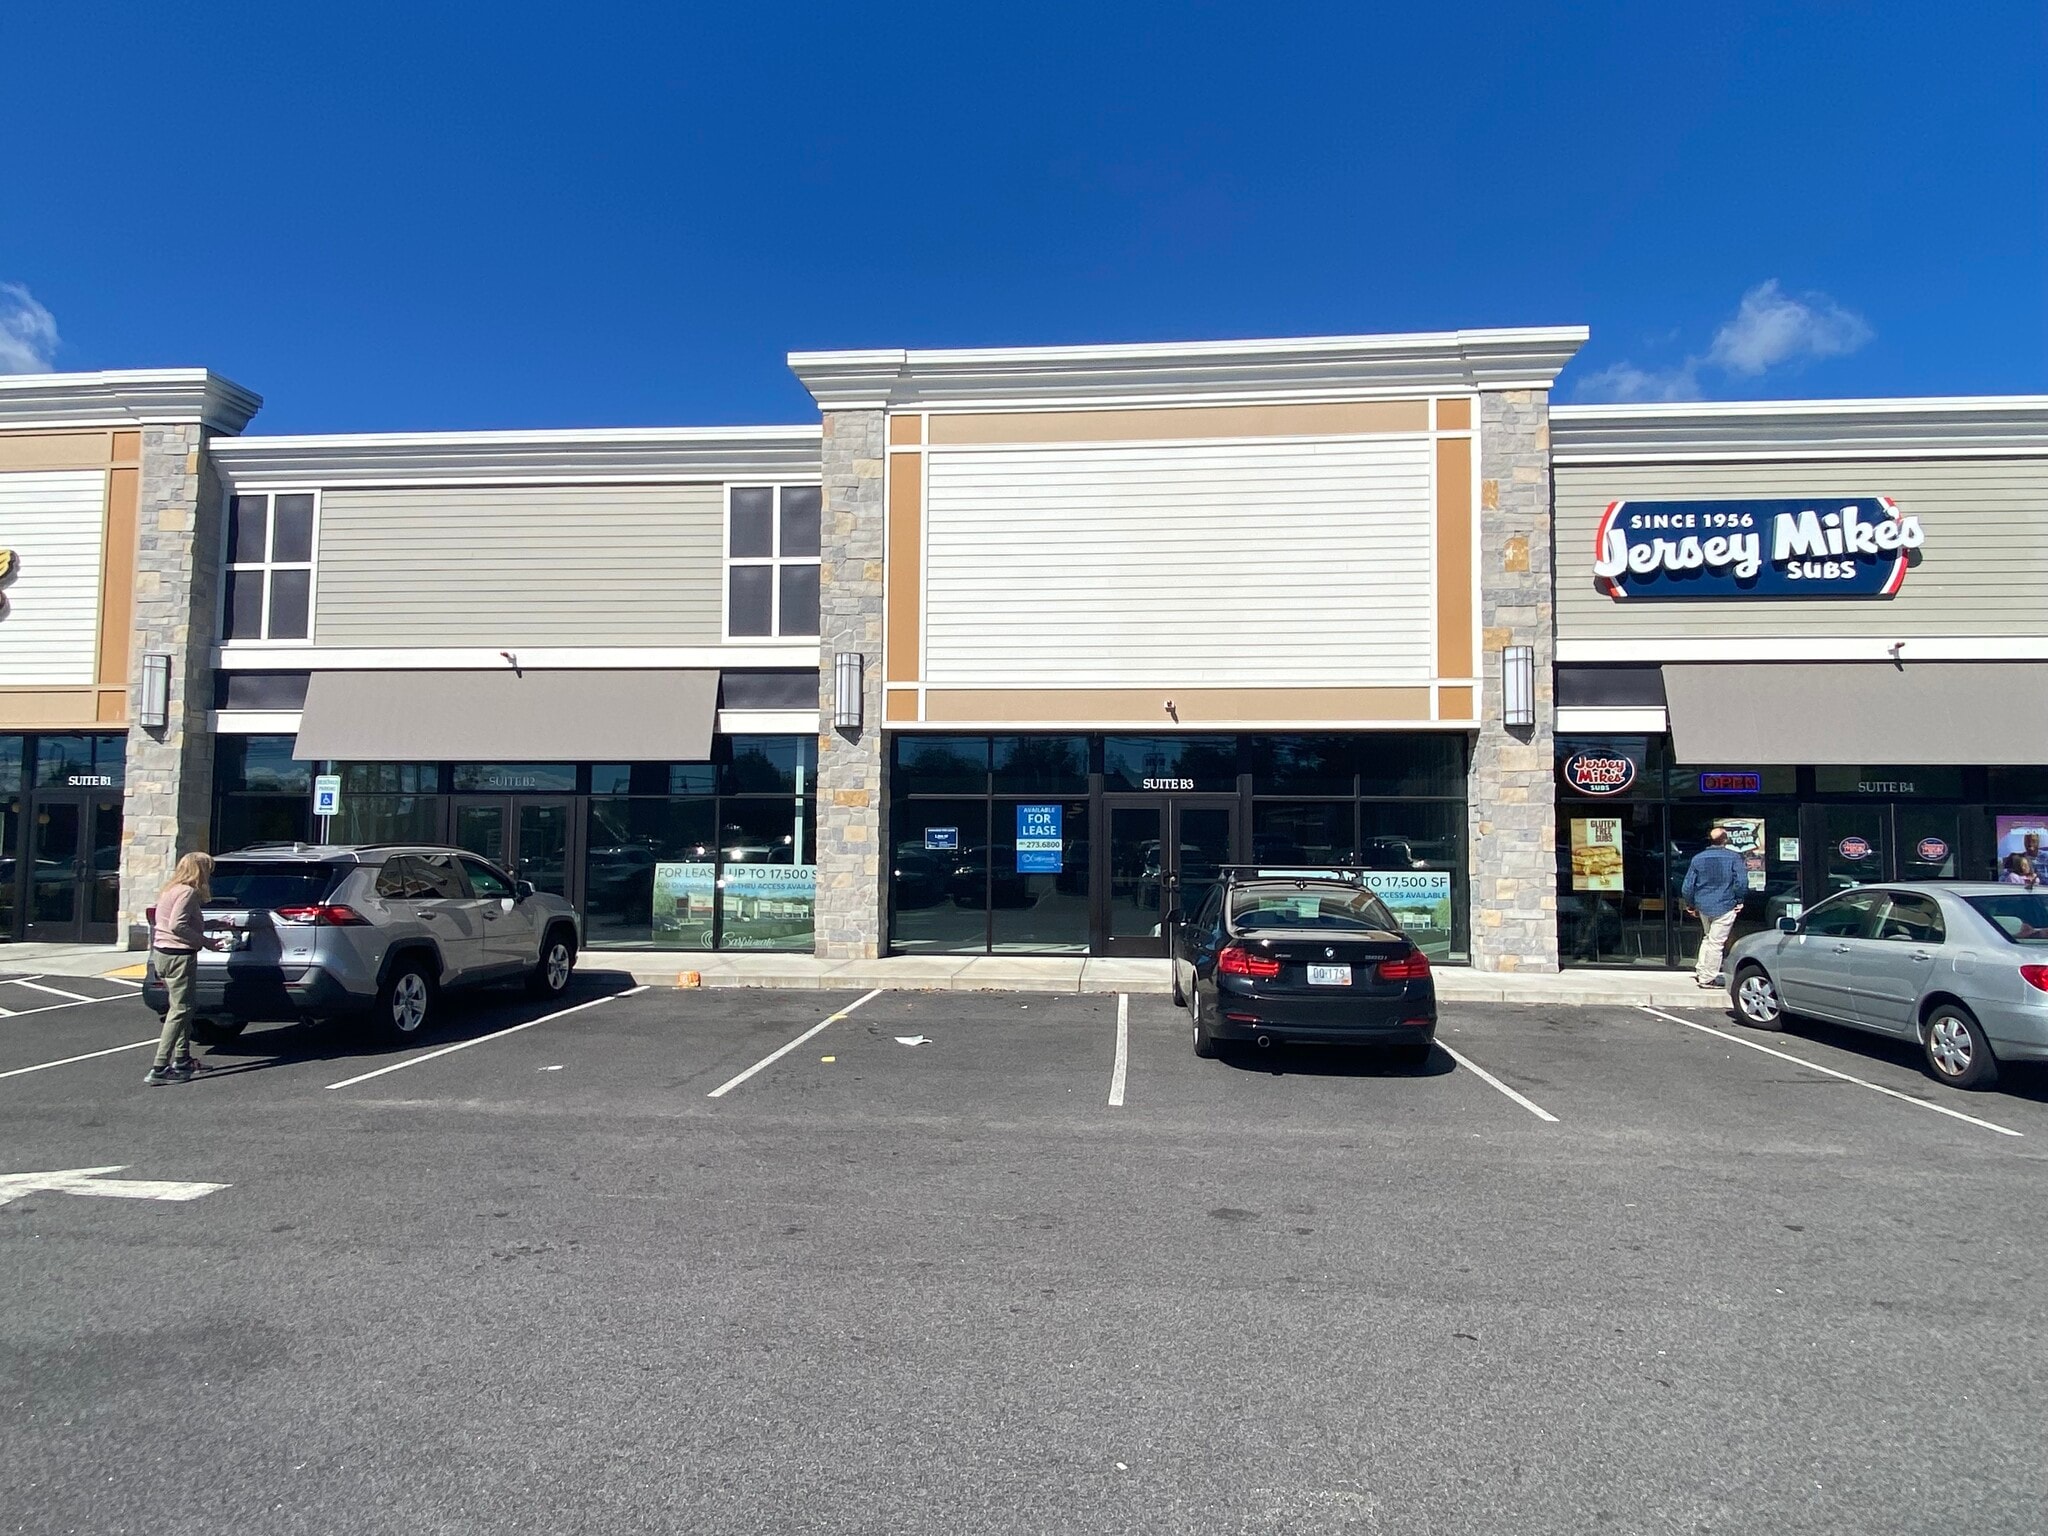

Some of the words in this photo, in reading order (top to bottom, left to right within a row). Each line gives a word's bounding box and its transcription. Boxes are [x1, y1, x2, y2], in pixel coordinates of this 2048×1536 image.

[1631, 514, 1696, 529] SINCE
[1703, 513, 1754, 528] 1956
[1593, 528, 1762, 578] Jersey
[1772, 506, 1925, 560] Mike's
[1787, 561, 1857, 580] SUBS
[1573, 756, 1627, 774] Jersey
[68, 775, 99, 786] SUITE
[100, 775, 112, 786] B1
[489, 776, 522, 787] SUITE
[1143, 778, 1179, 789] SUITE
[1180, 778, 1194, 790] B3
[1705, 776, 1757, 789] OPEN
[1858, 781, 1898, 793] SUITE
[1899, 781, 1915, 793] B4
[1027, 813, 1052, 824] FOR
[1590, 820, 1617, 828] GLUTEN
[1022, 825, 1057, 836] LEASE
[1731, 836, 1755, 844] TOUR
[657, 867, 682, 878] FOR
[685, 867, 715, 878] LEAS
[728, 867, 746, 878] UP
[749, 868, 766, 879] TO
[770, 869, 808, 881] 17,500
[1363, 876, 1382, 887] TO
[1385, 876, 1427, 888] 17,500
[1431, 876, 1448, 887] SF
[1405, 891, 1447, 899] AVAILABLE
